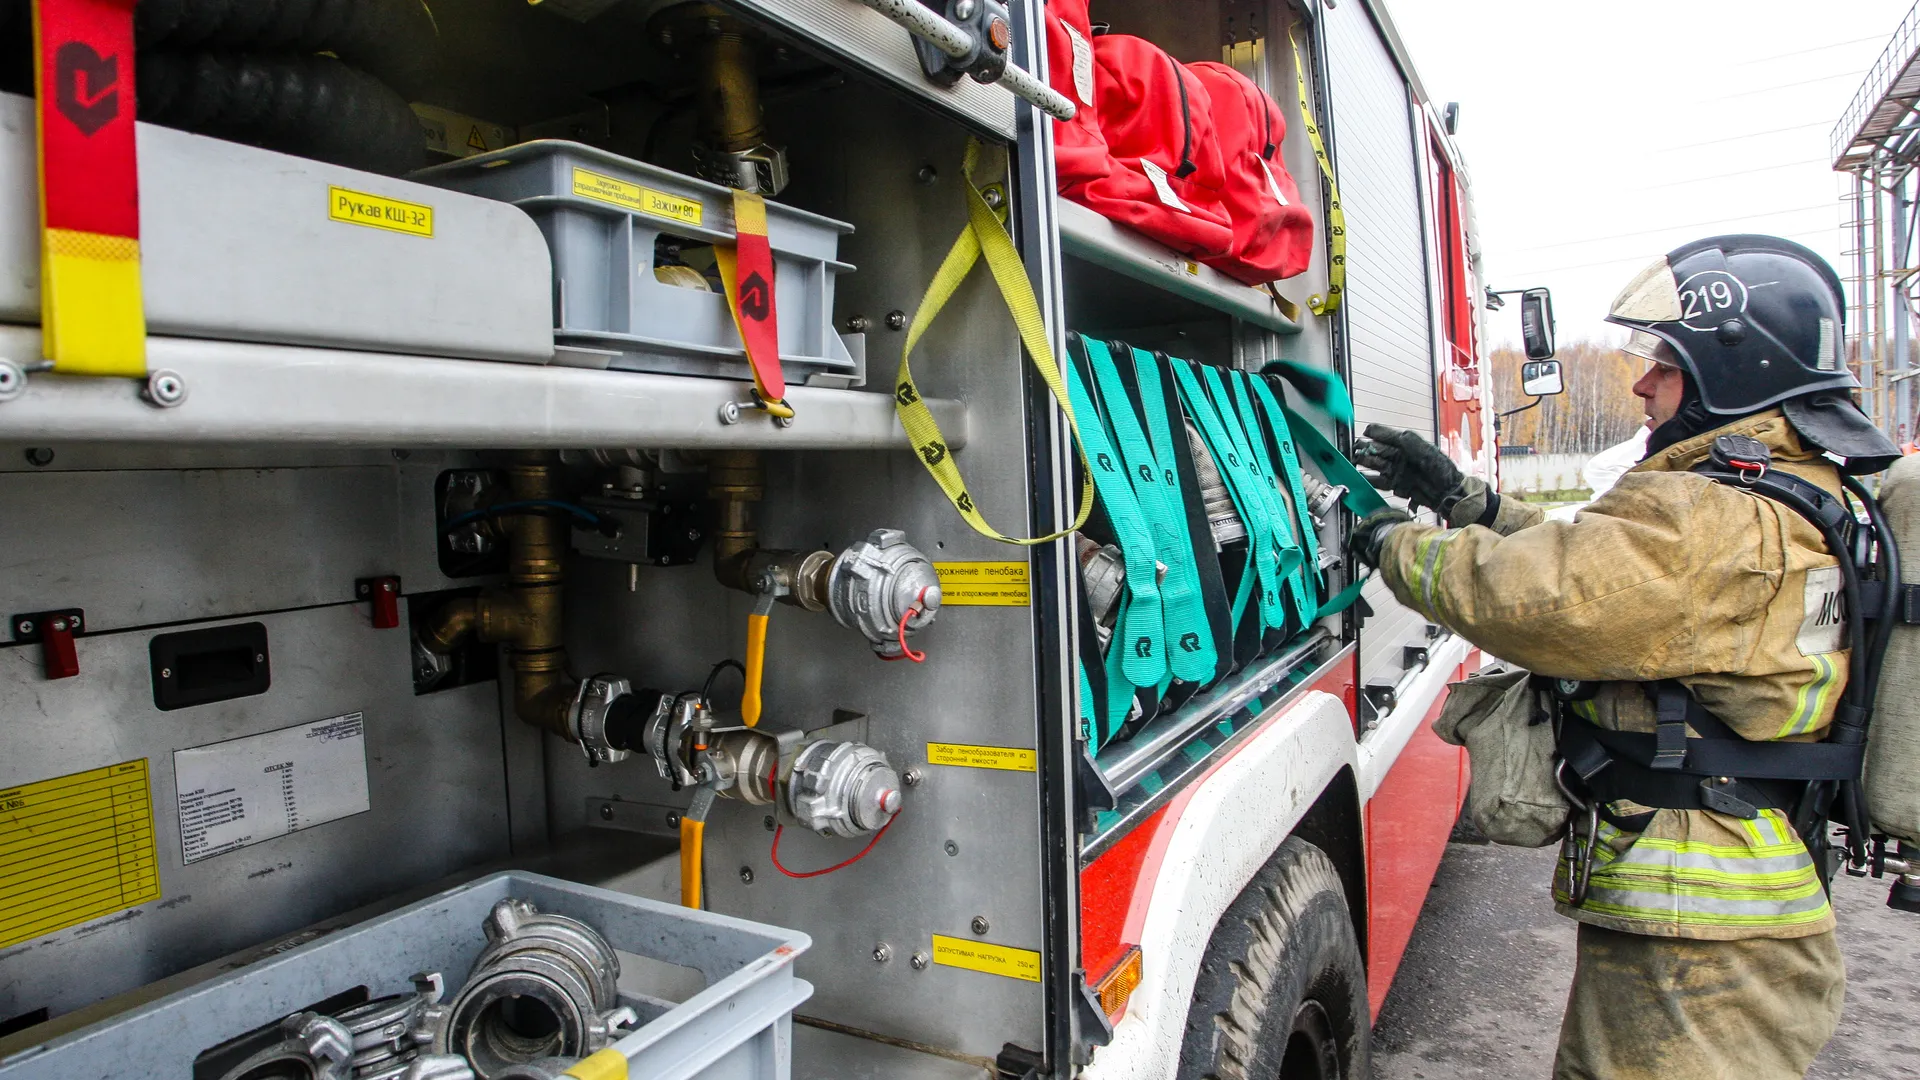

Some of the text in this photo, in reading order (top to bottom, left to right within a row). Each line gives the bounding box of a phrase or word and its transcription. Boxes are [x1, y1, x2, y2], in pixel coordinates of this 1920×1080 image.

[338, 195, 381, 218] Рукав
[651, 195, 694, 218] Зажим 80
[1680, 281, 1733, 320] 219
[935, 565, 1024, 578] орожнение пенобака
[1000, 589, 1028, 598] пенобака
[935, 745, 954, 755] Забор
[958, 748, 1015, 758] пенообразователя
[936, 755, 968, 763] сторонней
[937, 945, 975, 958] ДОПУСТИМАЯ
[977, 953, 1007, 964] НАГРУЗКА
[1017, 960, 1028, 968] 250
